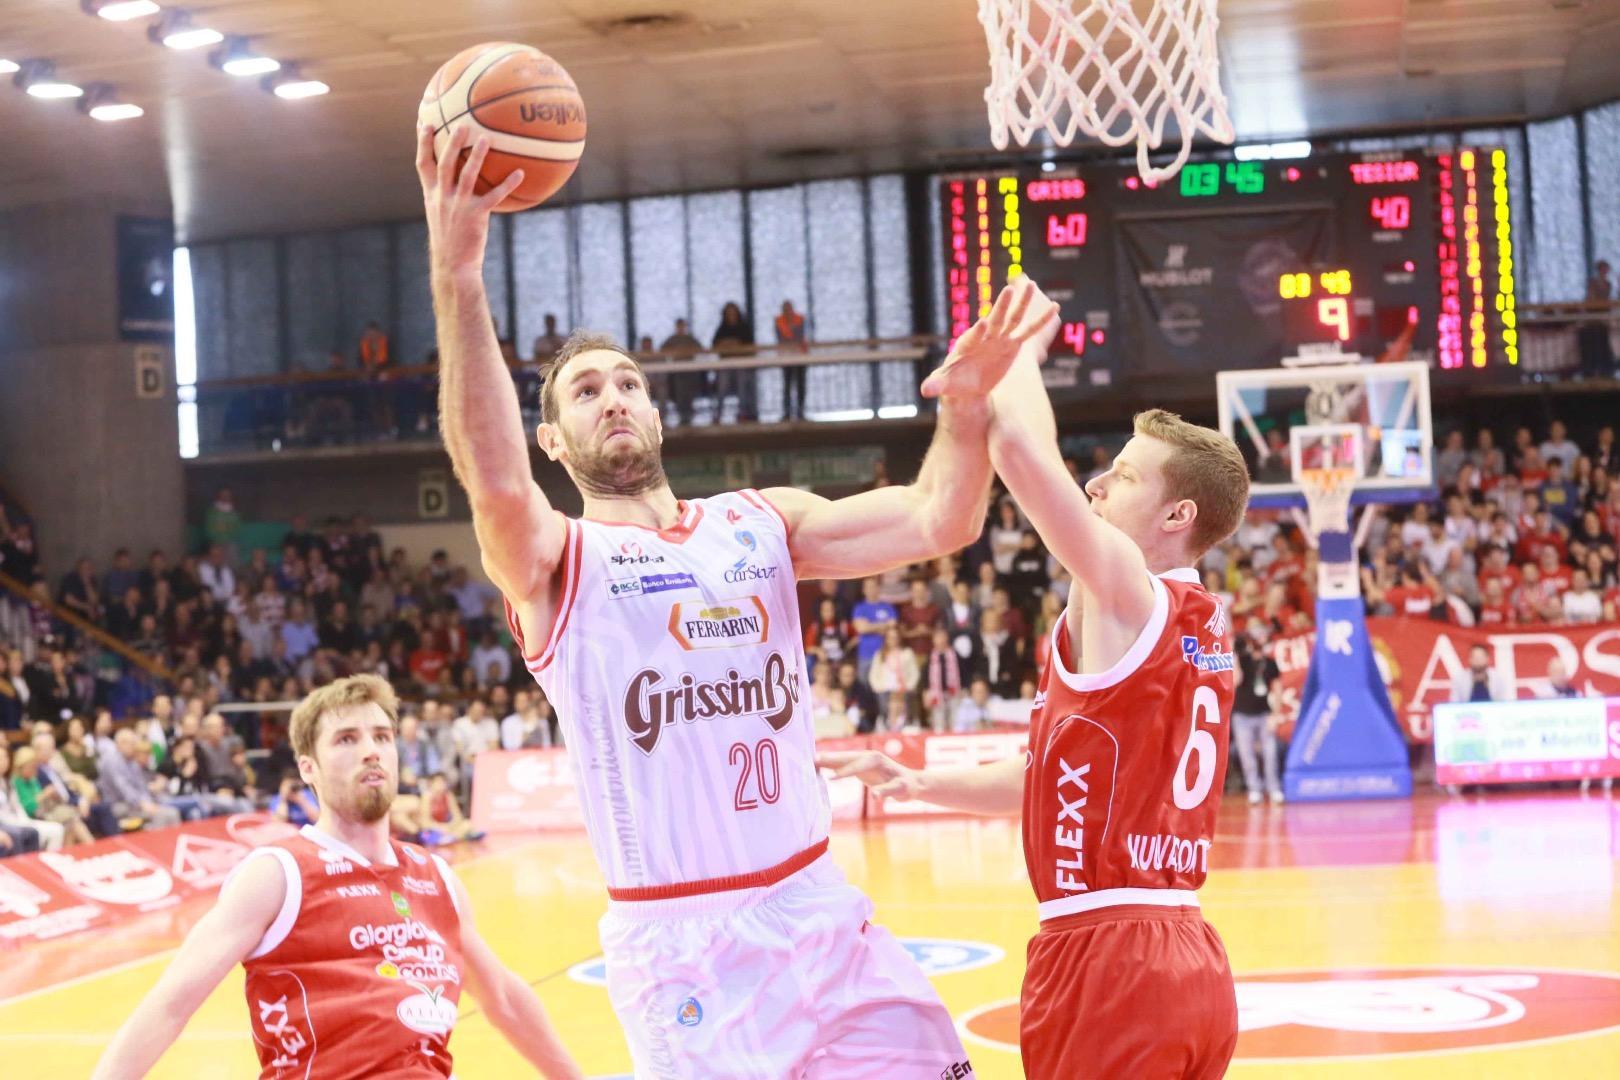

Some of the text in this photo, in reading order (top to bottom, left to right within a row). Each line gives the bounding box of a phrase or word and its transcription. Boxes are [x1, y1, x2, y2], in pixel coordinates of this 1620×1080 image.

[1047, 213, 1088, 246] 60
[1371, 196, 1411, 228] 40
[1317, 298, 1350, 341] 9
[685, 616, 760, 639] FERRARINI
[1172, 685, 1221, 810] 6
[728, 738, 781, 812] 20
[1056, 757, 1091, 891] FLEXX
